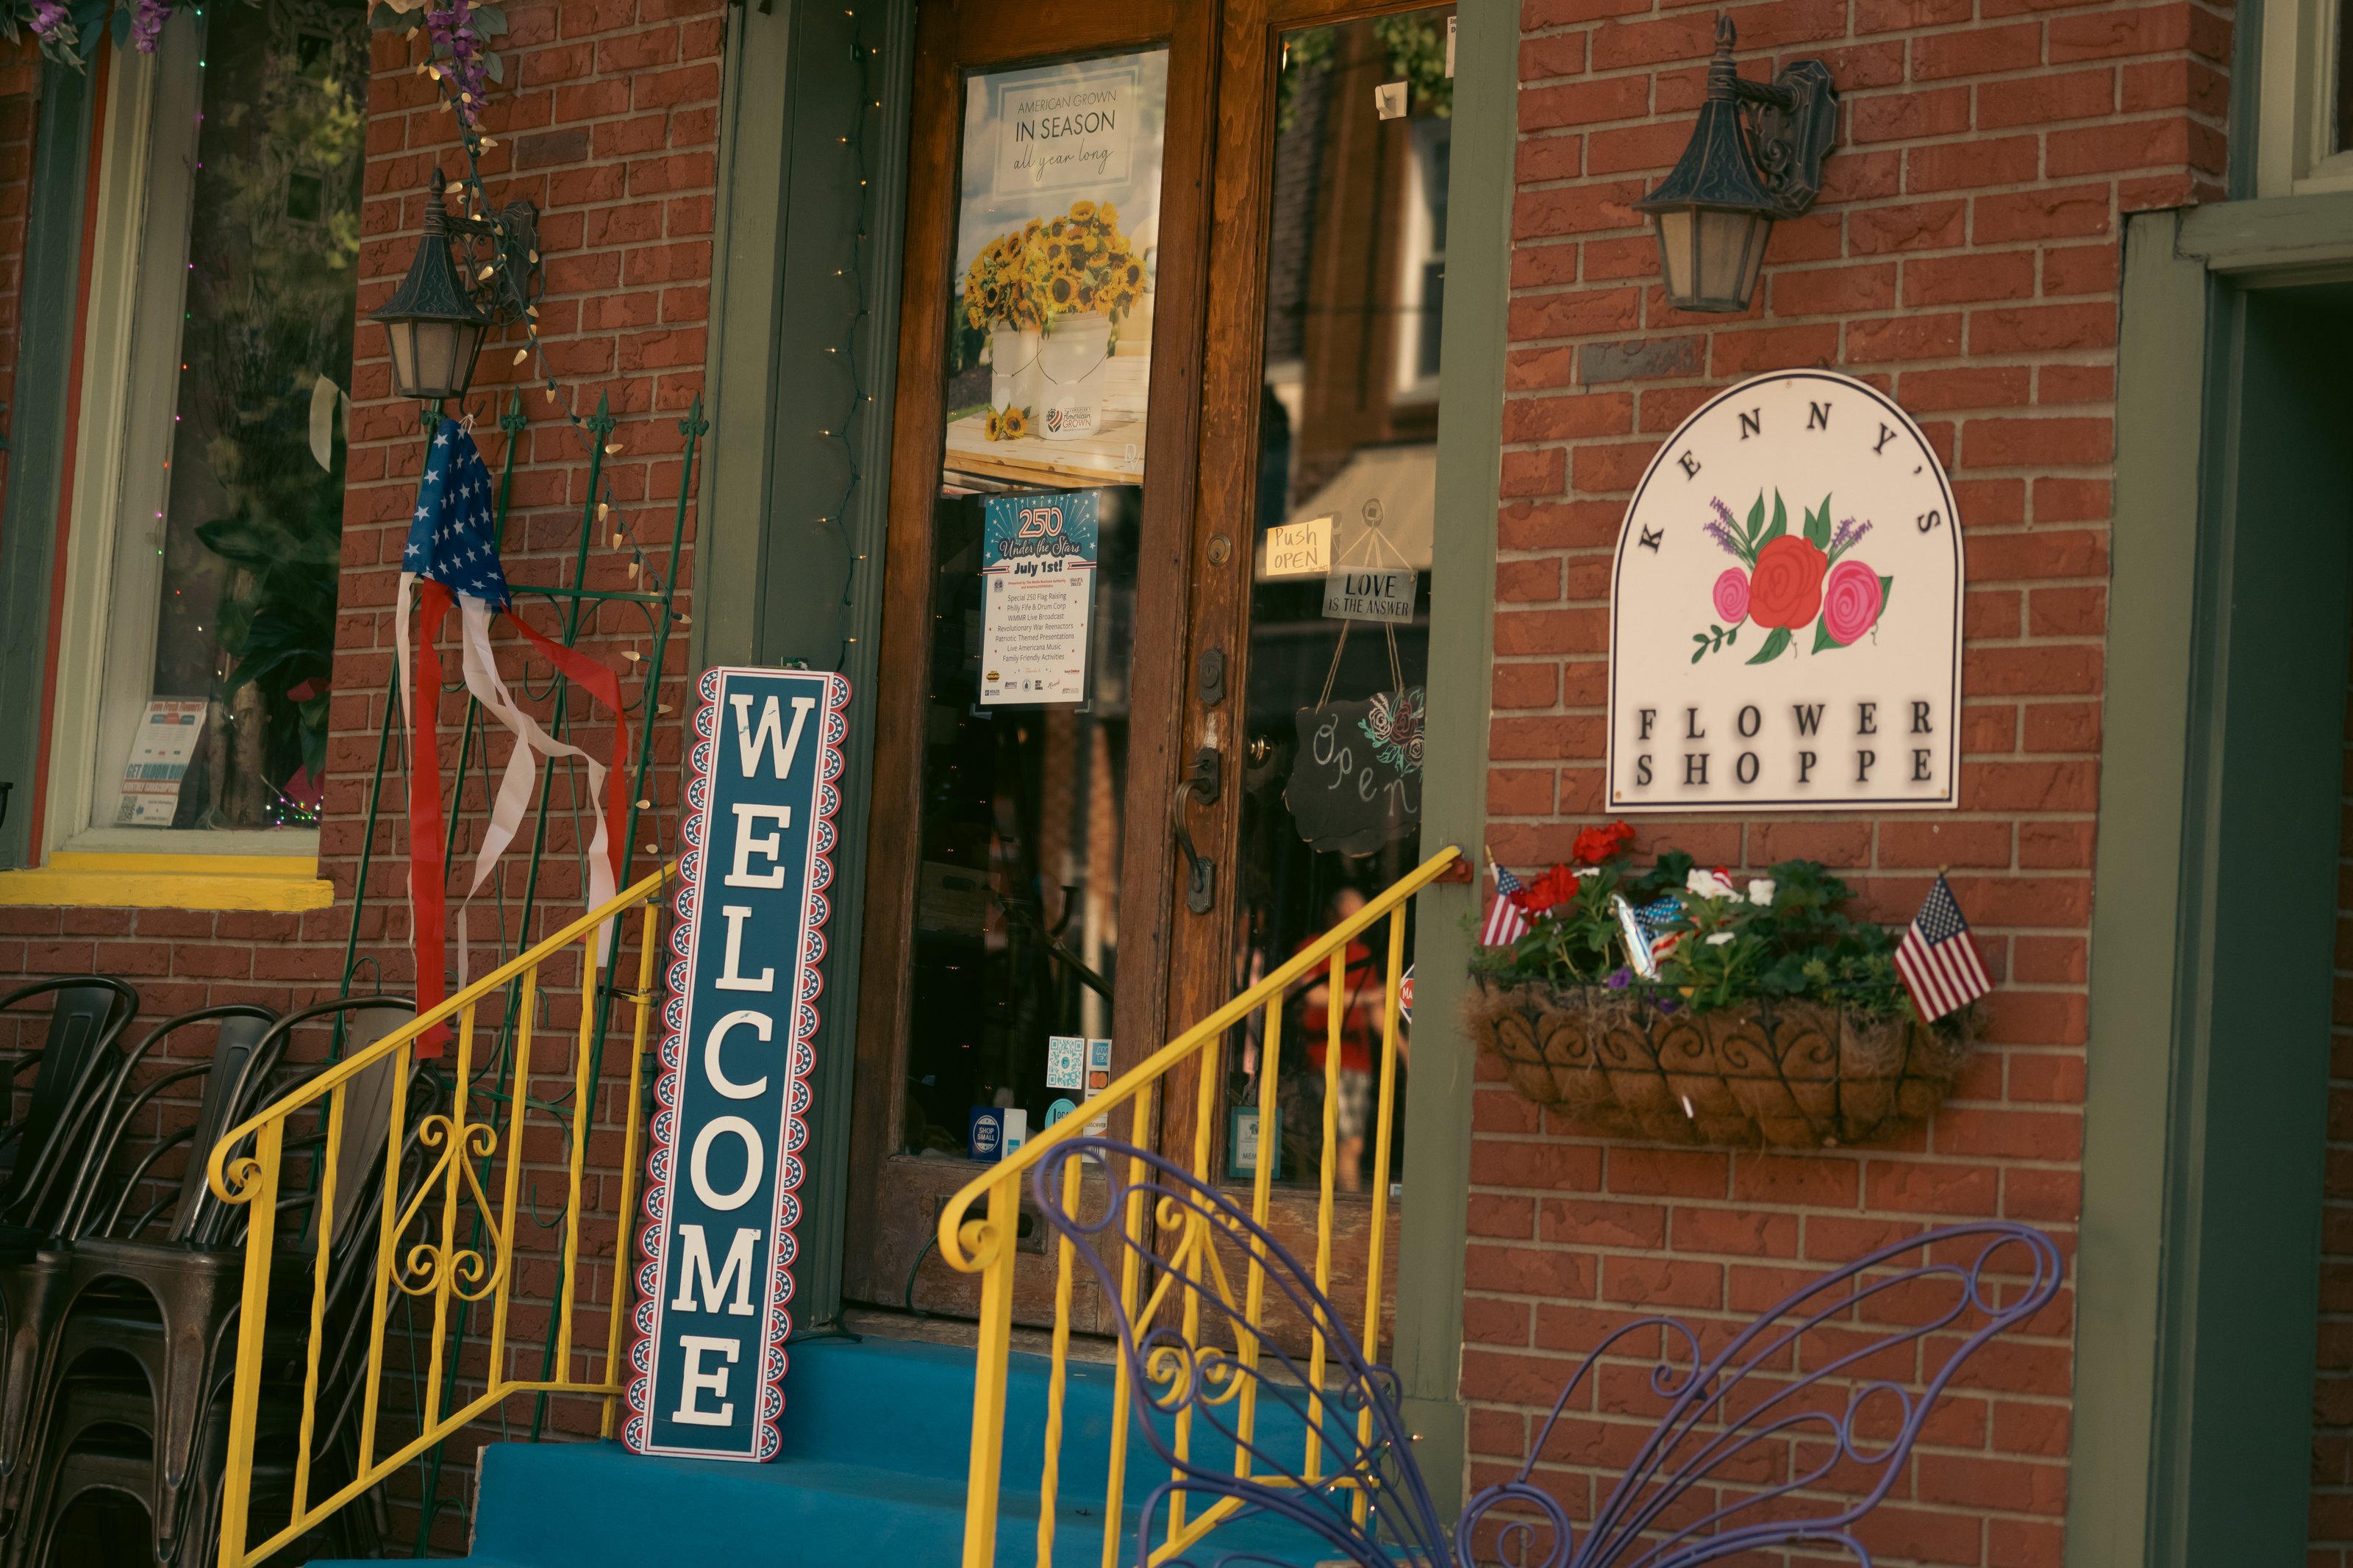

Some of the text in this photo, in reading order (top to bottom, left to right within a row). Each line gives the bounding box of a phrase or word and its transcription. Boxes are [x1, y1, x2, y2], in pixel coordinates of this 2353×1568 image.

[1018, 90, 1116, 114] AMERICAN GROWN
[1015, 110, 1115, 142] IN SEASON
[1013, 137, 1115, 182] all year long
[1063, 410, 1091, 420] American
[1063, 419, 1091, 428] GROWN
[1639, 401, 1941, 554] KENNY'S
[1018, 507, 1063, 538] 250
[999, 535, 1081, 557] Under the Stars
[1275, 523, 1316, 547] Push
[1014, 559, 1063, 577] July 1st!
[1274, 547, 1318, 568] OPEN
[1346, 573, 1396, 598] LOVE
[1007, 604, 1021, 612] Philly
[1053, 603, 1066, 611] Corp
[1008, 594, 1026, 603] Special
[1038, 593, 1048, 602] Flag
[1049, 593, 1067, 601] Raising
[1329, 598, 1409, 616] IS THE ANSWER
[1003, 653, 1065, 663] Family Friendly Activities
[1638, 701, 1933, 740] FLOWER
[126, 763, 143, 778] GET
[1313, 713, 1418, 817] Open
[1637, 749, 1932, 786] SHOPPE
[1402, 987, 1413, 1000] MA
[671, 694, 816, 1428] WELCOME
[1243, 1152, 1257, 1160] MEM
